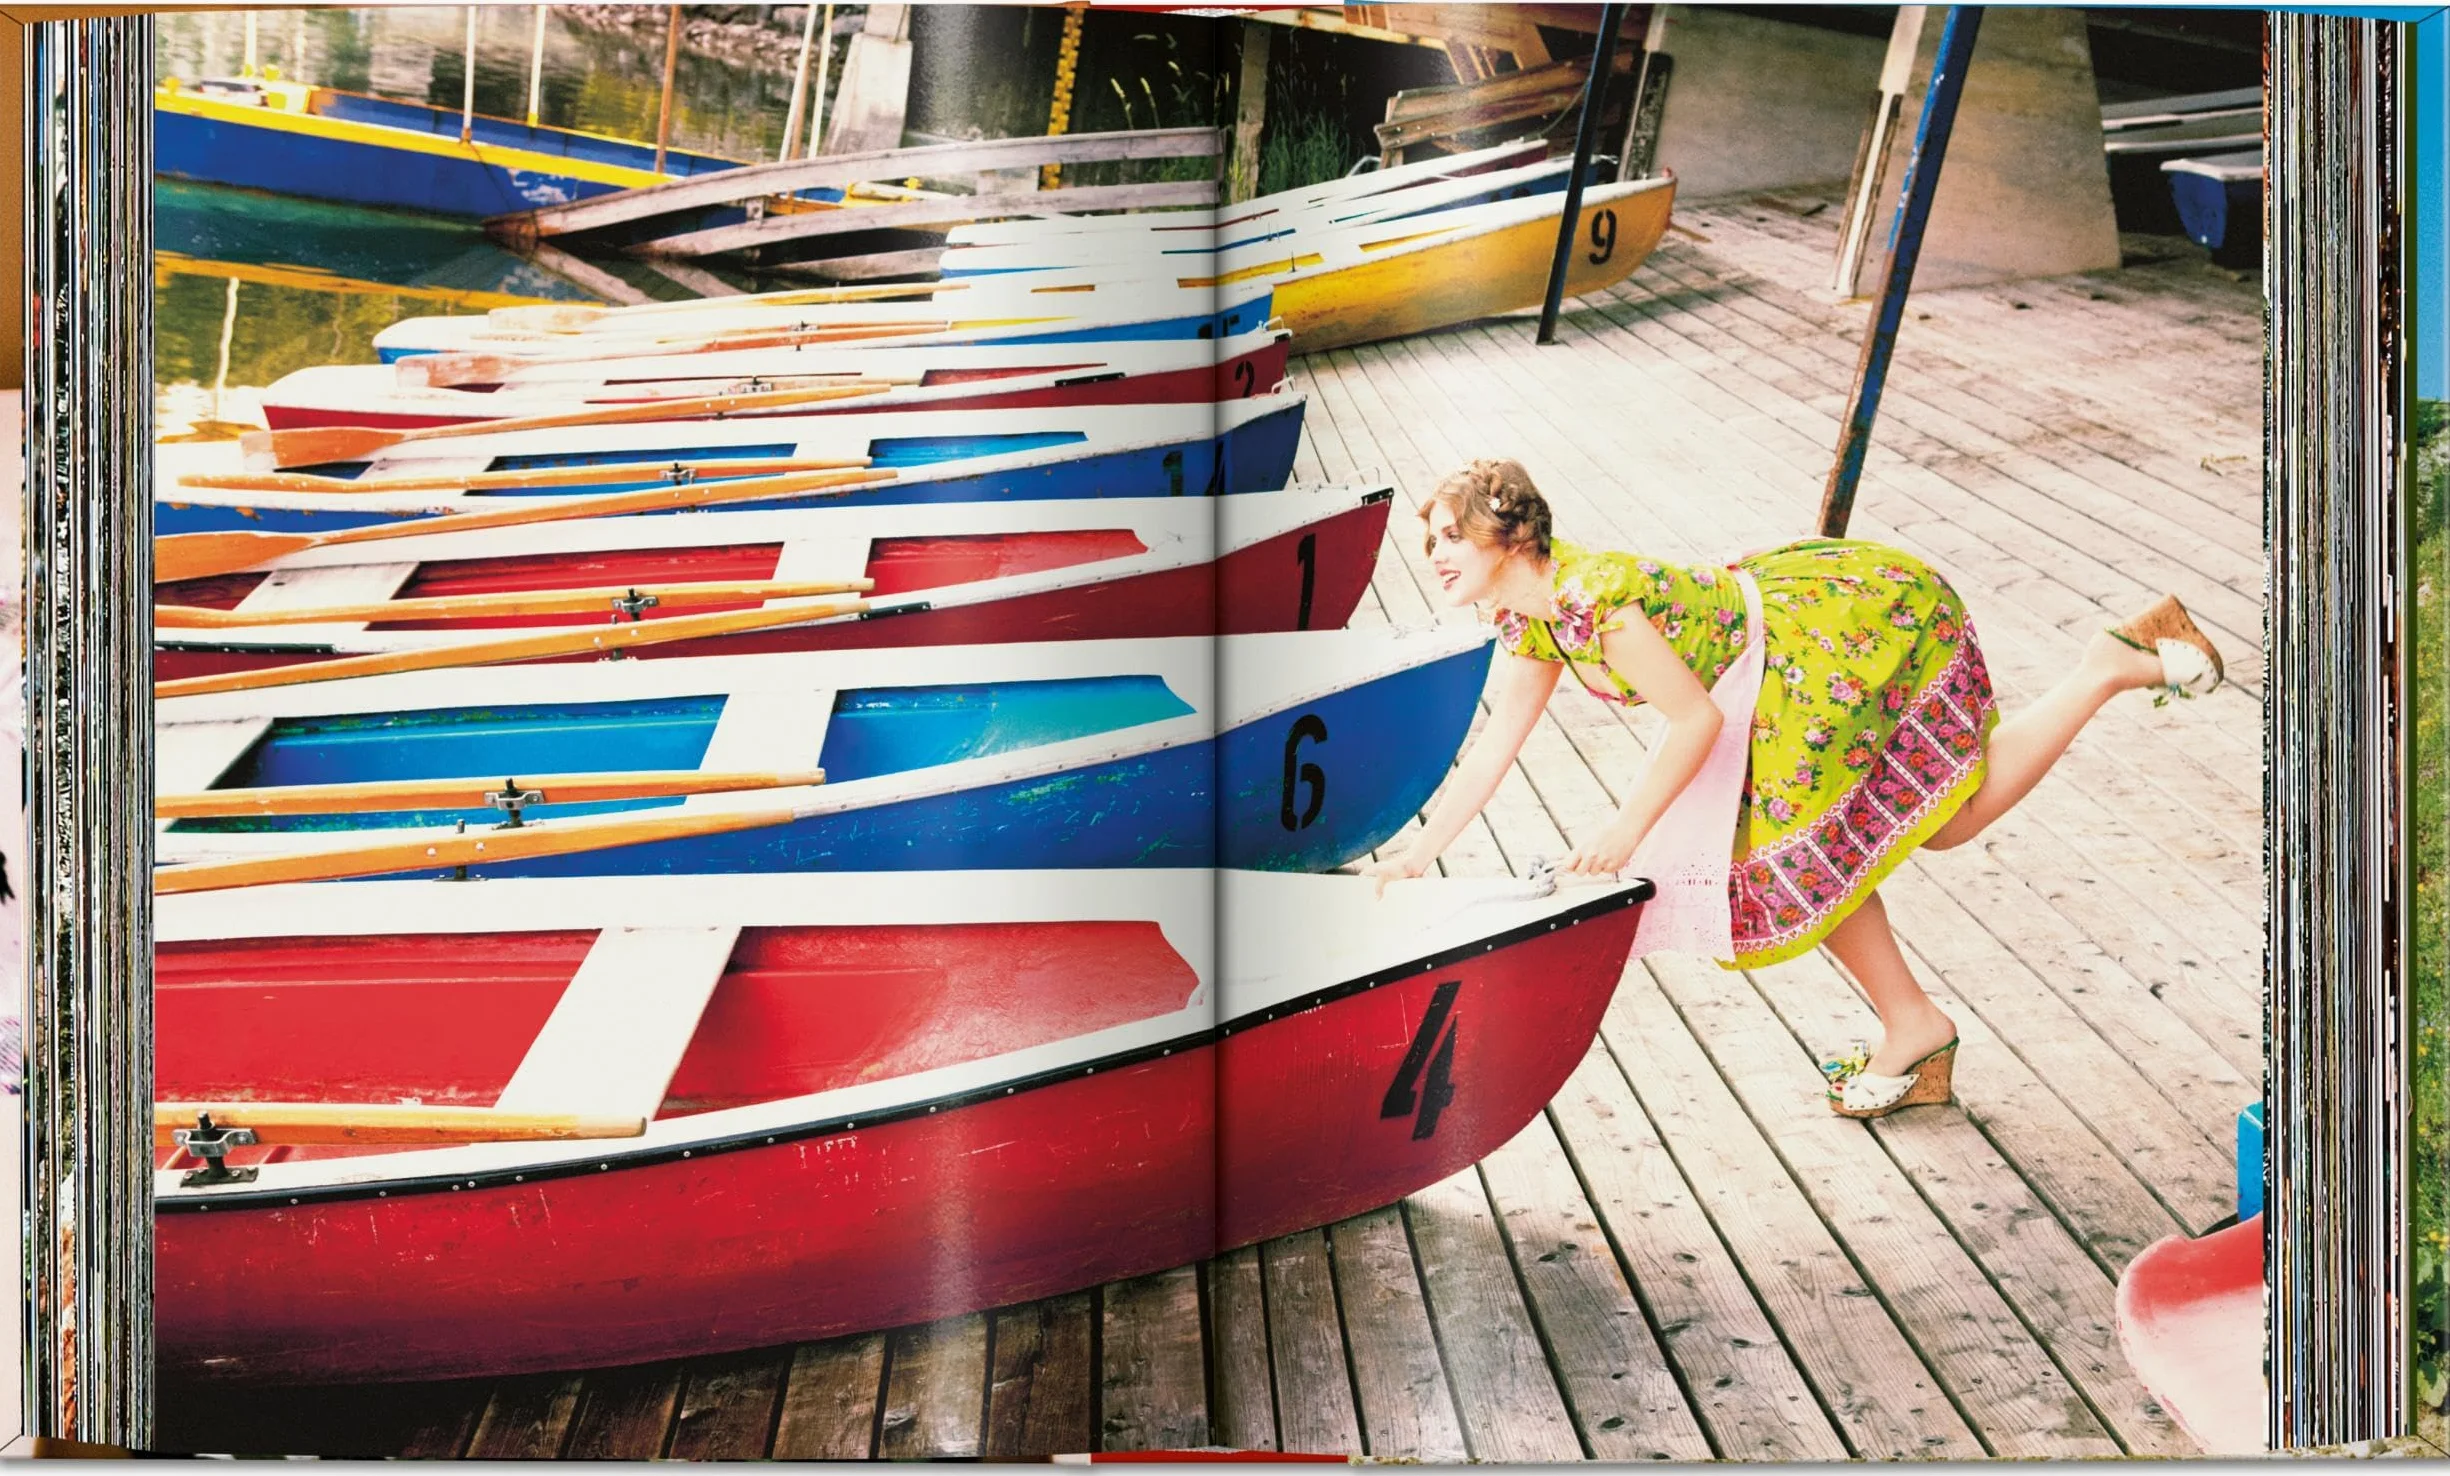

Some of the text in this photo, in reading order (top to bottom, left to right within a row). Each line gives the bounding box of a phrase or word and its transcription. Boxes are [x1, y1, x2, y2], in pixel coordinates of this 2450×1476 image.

[1589, 208, 1617, 265] 9
[1235, 360, 1254, 398] 2
[1297, 533, 1316, 631] 1
[1281, 714, 1327, 832] 6
[1380, 980, 1462, 1141] 4
